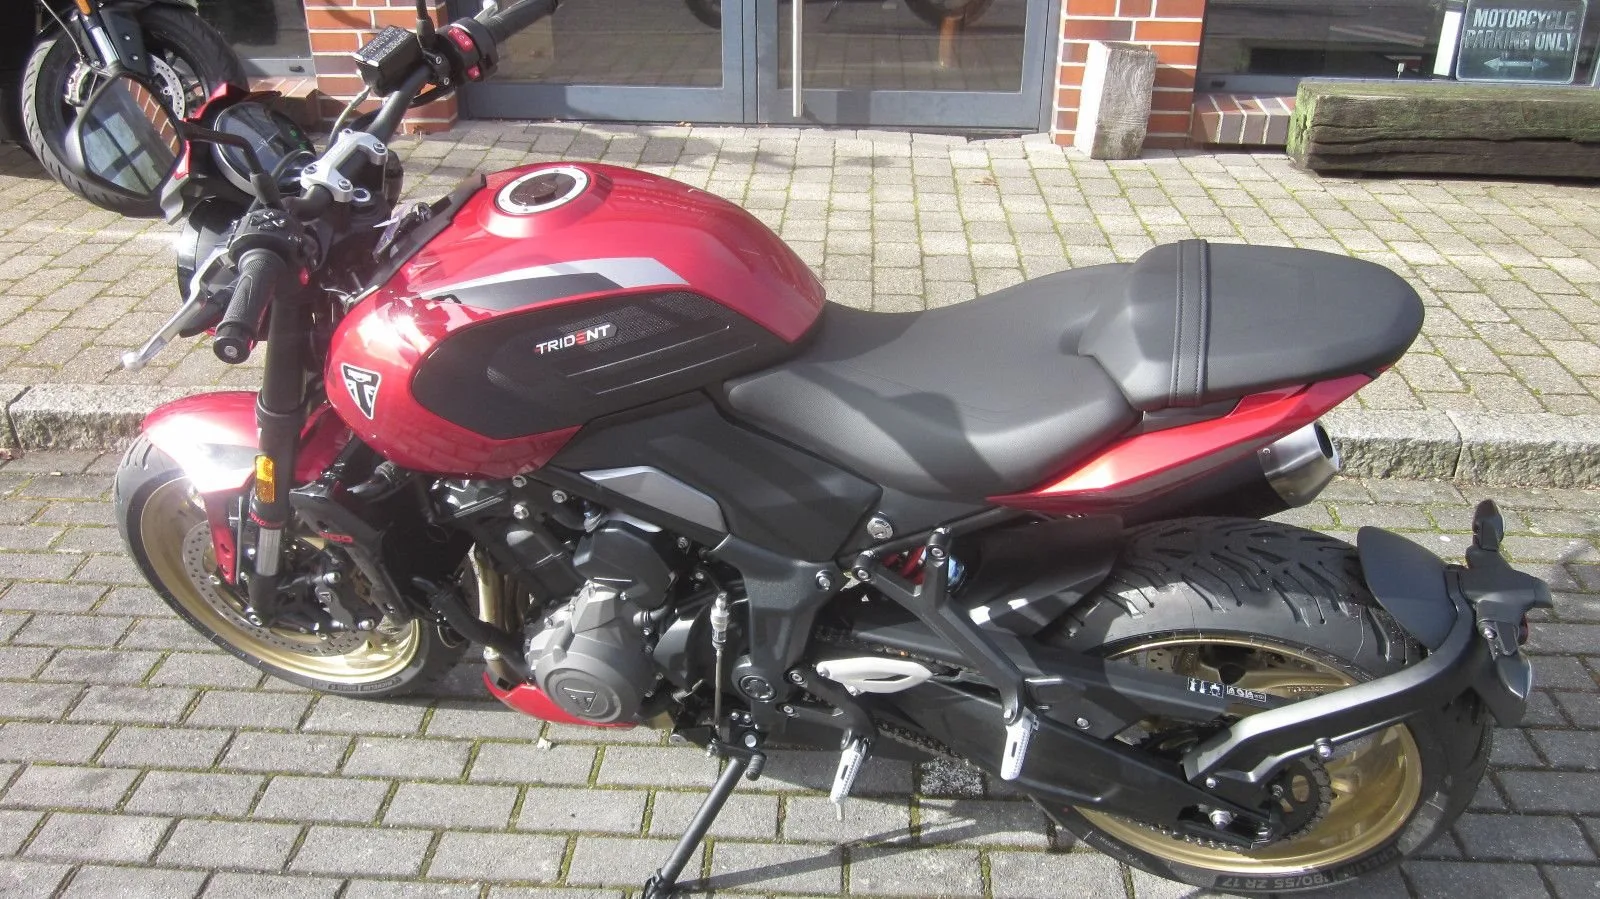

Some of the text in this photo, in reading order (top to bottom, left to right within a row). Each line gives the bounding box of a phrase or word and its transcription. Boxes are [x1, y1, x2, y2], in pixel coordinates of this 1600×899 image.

[1473, 8, 1577, 30] MOTORCYCLE
[1464, 29, 1576, 51] PARKING ONLY
[535, 324, 611, 355] TRIDENT
[1222, 878, 1240, 887] 17
[1245, 879, 1267, 889] ZR
